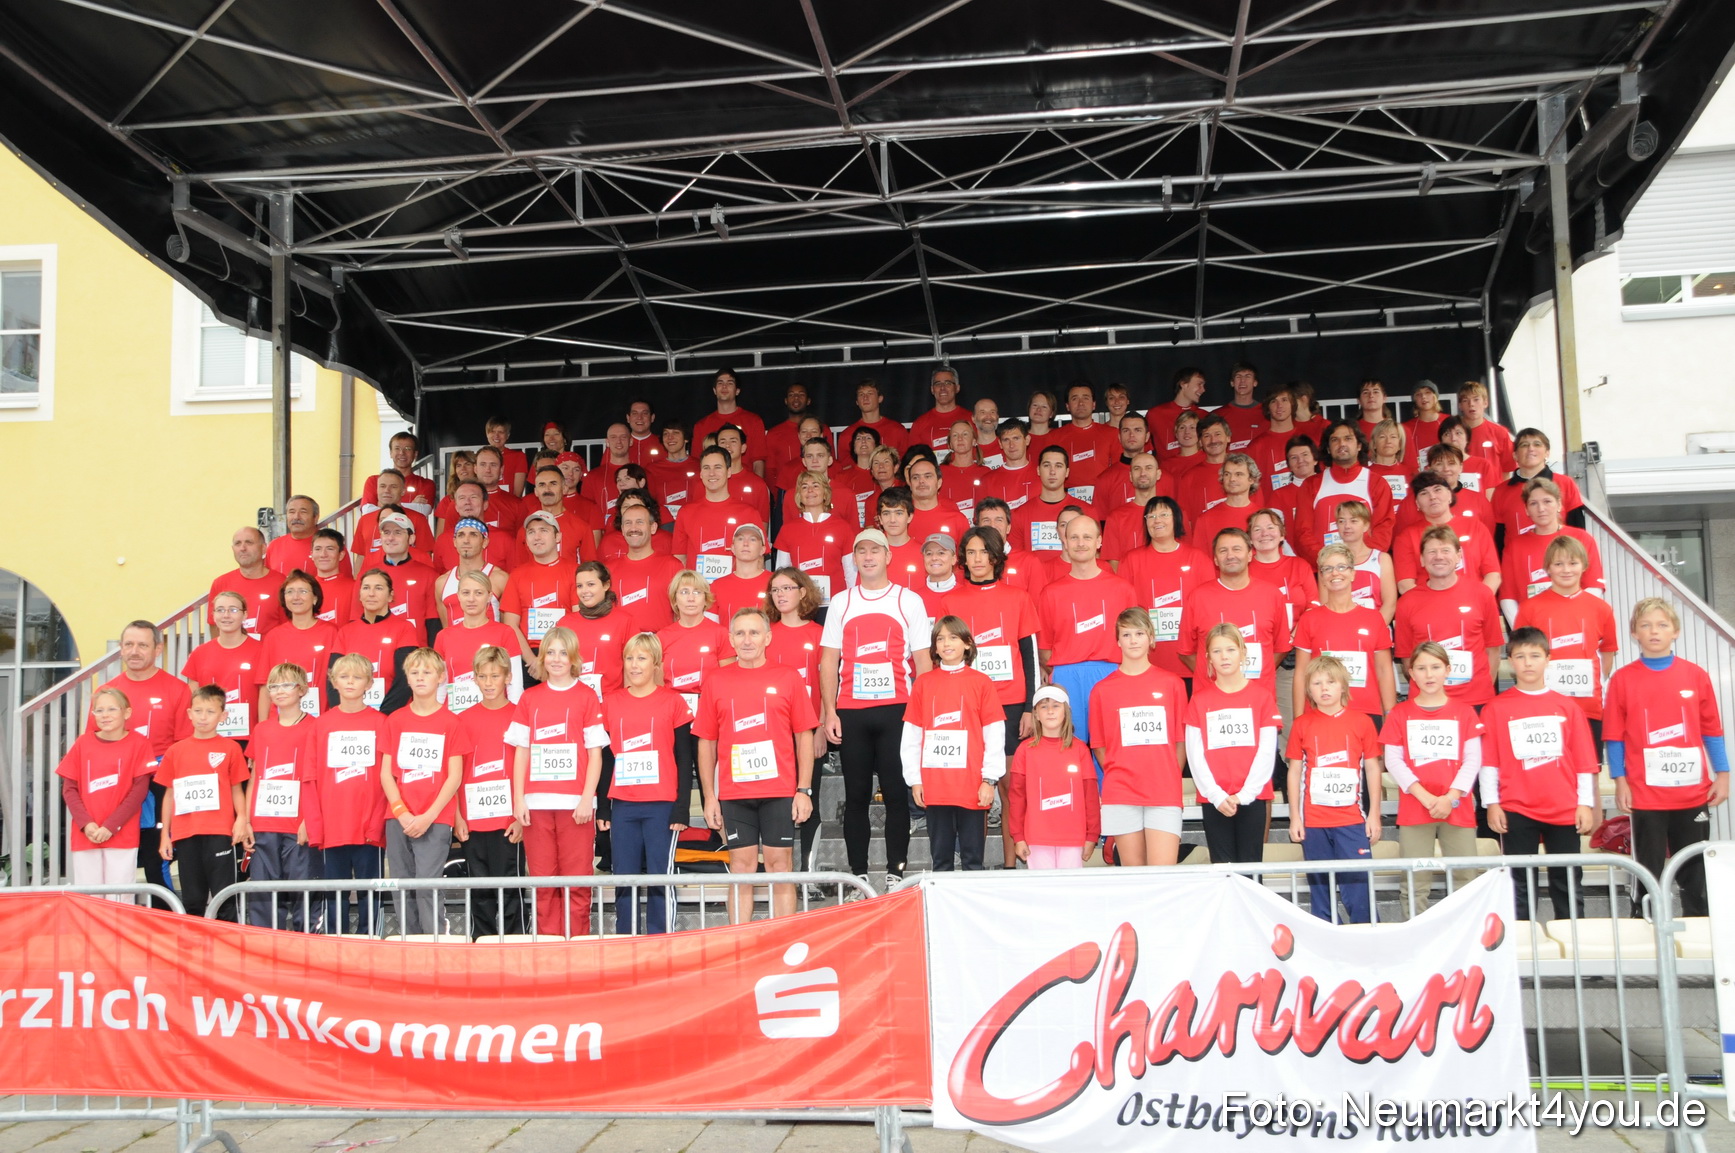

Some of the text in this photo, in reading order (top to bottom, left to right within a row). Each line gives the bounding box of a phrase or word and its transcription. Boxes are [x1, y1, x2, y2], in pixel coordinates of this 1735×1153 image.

[1042, 532, 1061, 540] 234
[706, 566, 727, 574] 2007
[1160, 610, 1174, 618] Doris
[538, 620, 558, 628] 232
[980, 660, 1007, 671] 5031
[864, 677, 890, 688] 2332
[1558, 674, 1588, 685] 4030
[455, 694, 479, 705] 5044
[1132, 710, 1154, 718] Kathrin
[1134, 722, 1162, 732] 4034
[1220, 724, 1248, 735] 4033
[410, 736, 428, 744] Daniel
[1421, 735, 1453, 746] 4022
[1526, 732, 1558, 744] 4023
[341, 745, 370, 755] 4036
[410, 748, 438, 759] 4035
[740, 747, 757, 756] Josef
[933, 746, 961, 756] 4021
[1658, 750, 1682, 758] Stefan
[544, 758, 573, 768] 5053
[626, 761, 652, 772] 3718
[746, 756, 768, 769] 100
[1661, 762, 1695, 774] 4027
[183, 779, 206, 787] Thomas
[266, 783, 283, 791] Oliver
[1324, 783, 1352, 793] 4025
[184, 788, 214, 800] 4032
[476, 785, 506, 793] Alexander
[266, 795, 293, 805] 4031
[478, 794, 507, 806] 4026
[947, 912, 1505, 1126] Charivari
[192, 992, 603, 1063] willkommen
